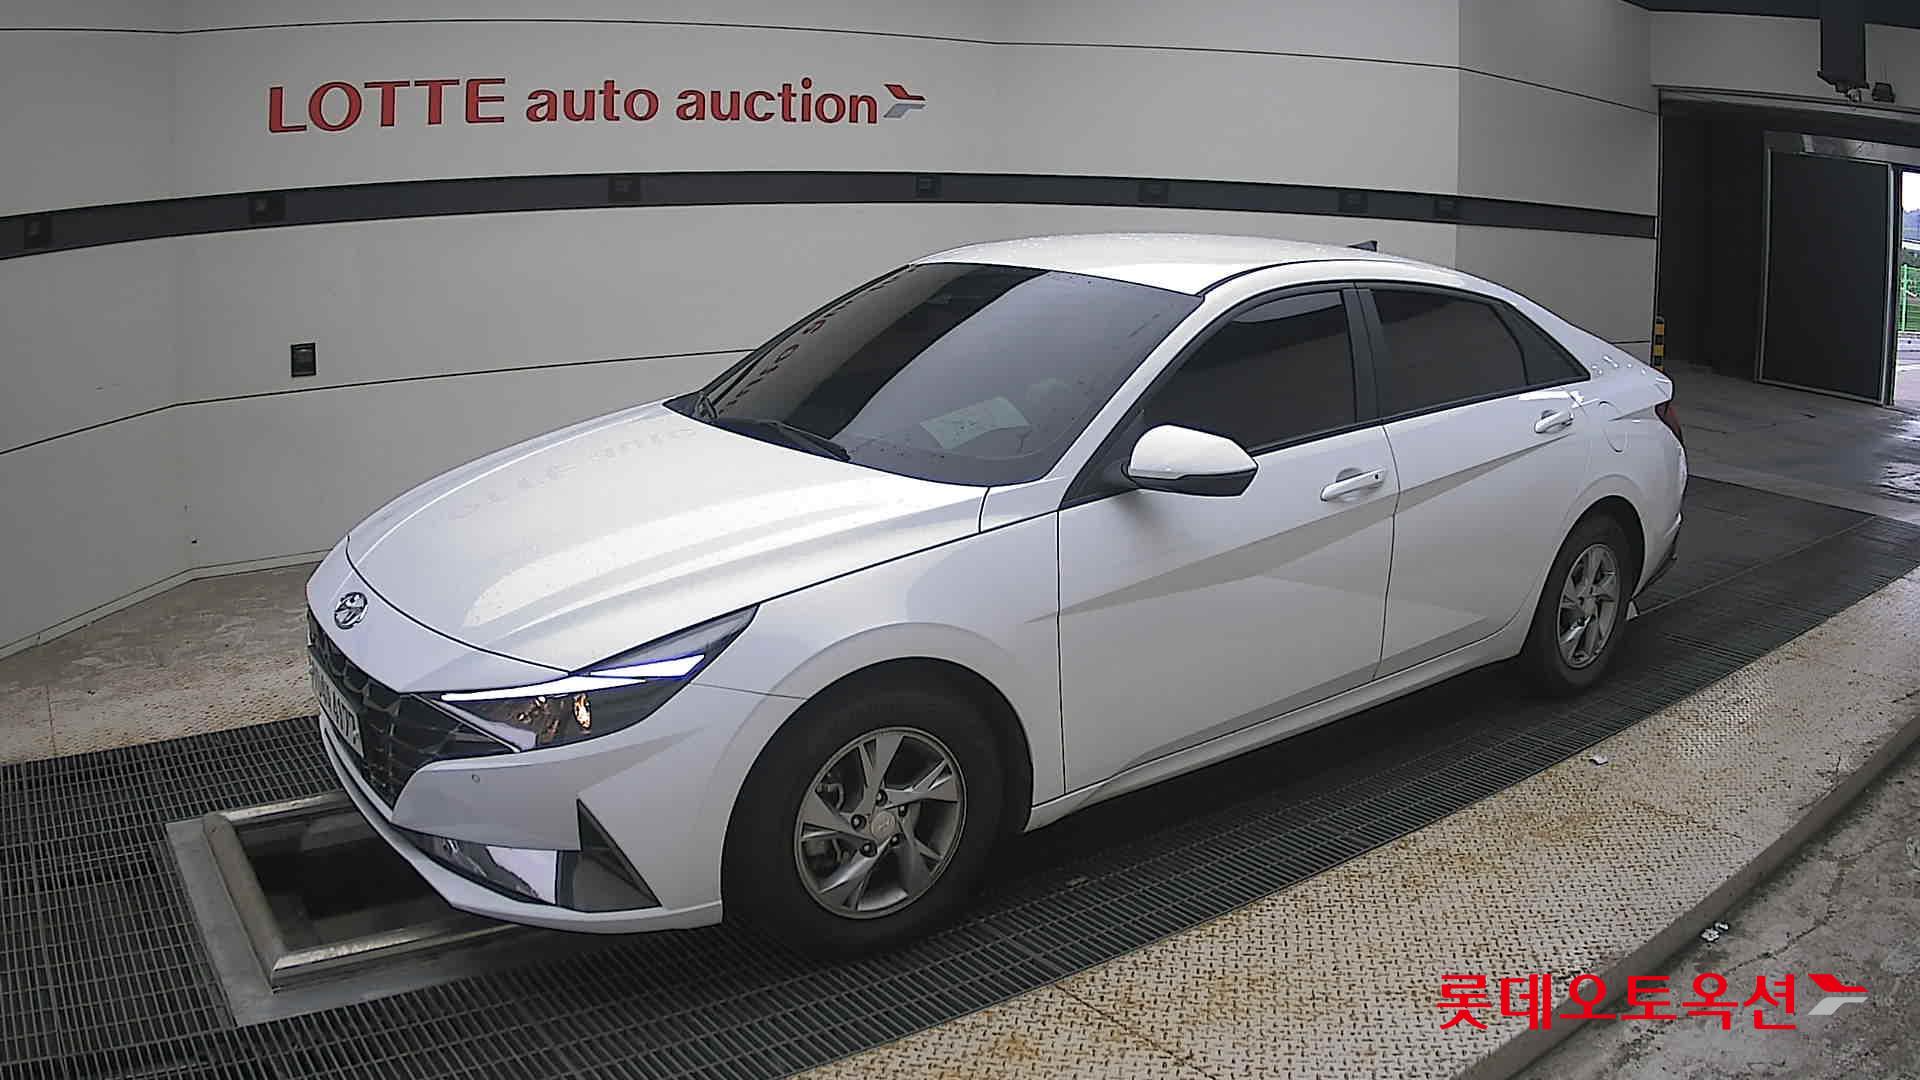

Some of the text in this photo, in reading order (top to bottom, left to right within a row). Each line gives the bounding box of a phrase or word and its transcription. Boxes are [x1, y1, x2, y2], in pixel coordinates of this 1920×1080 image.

[269, 77, 878, 132] LOTTE auto auction
